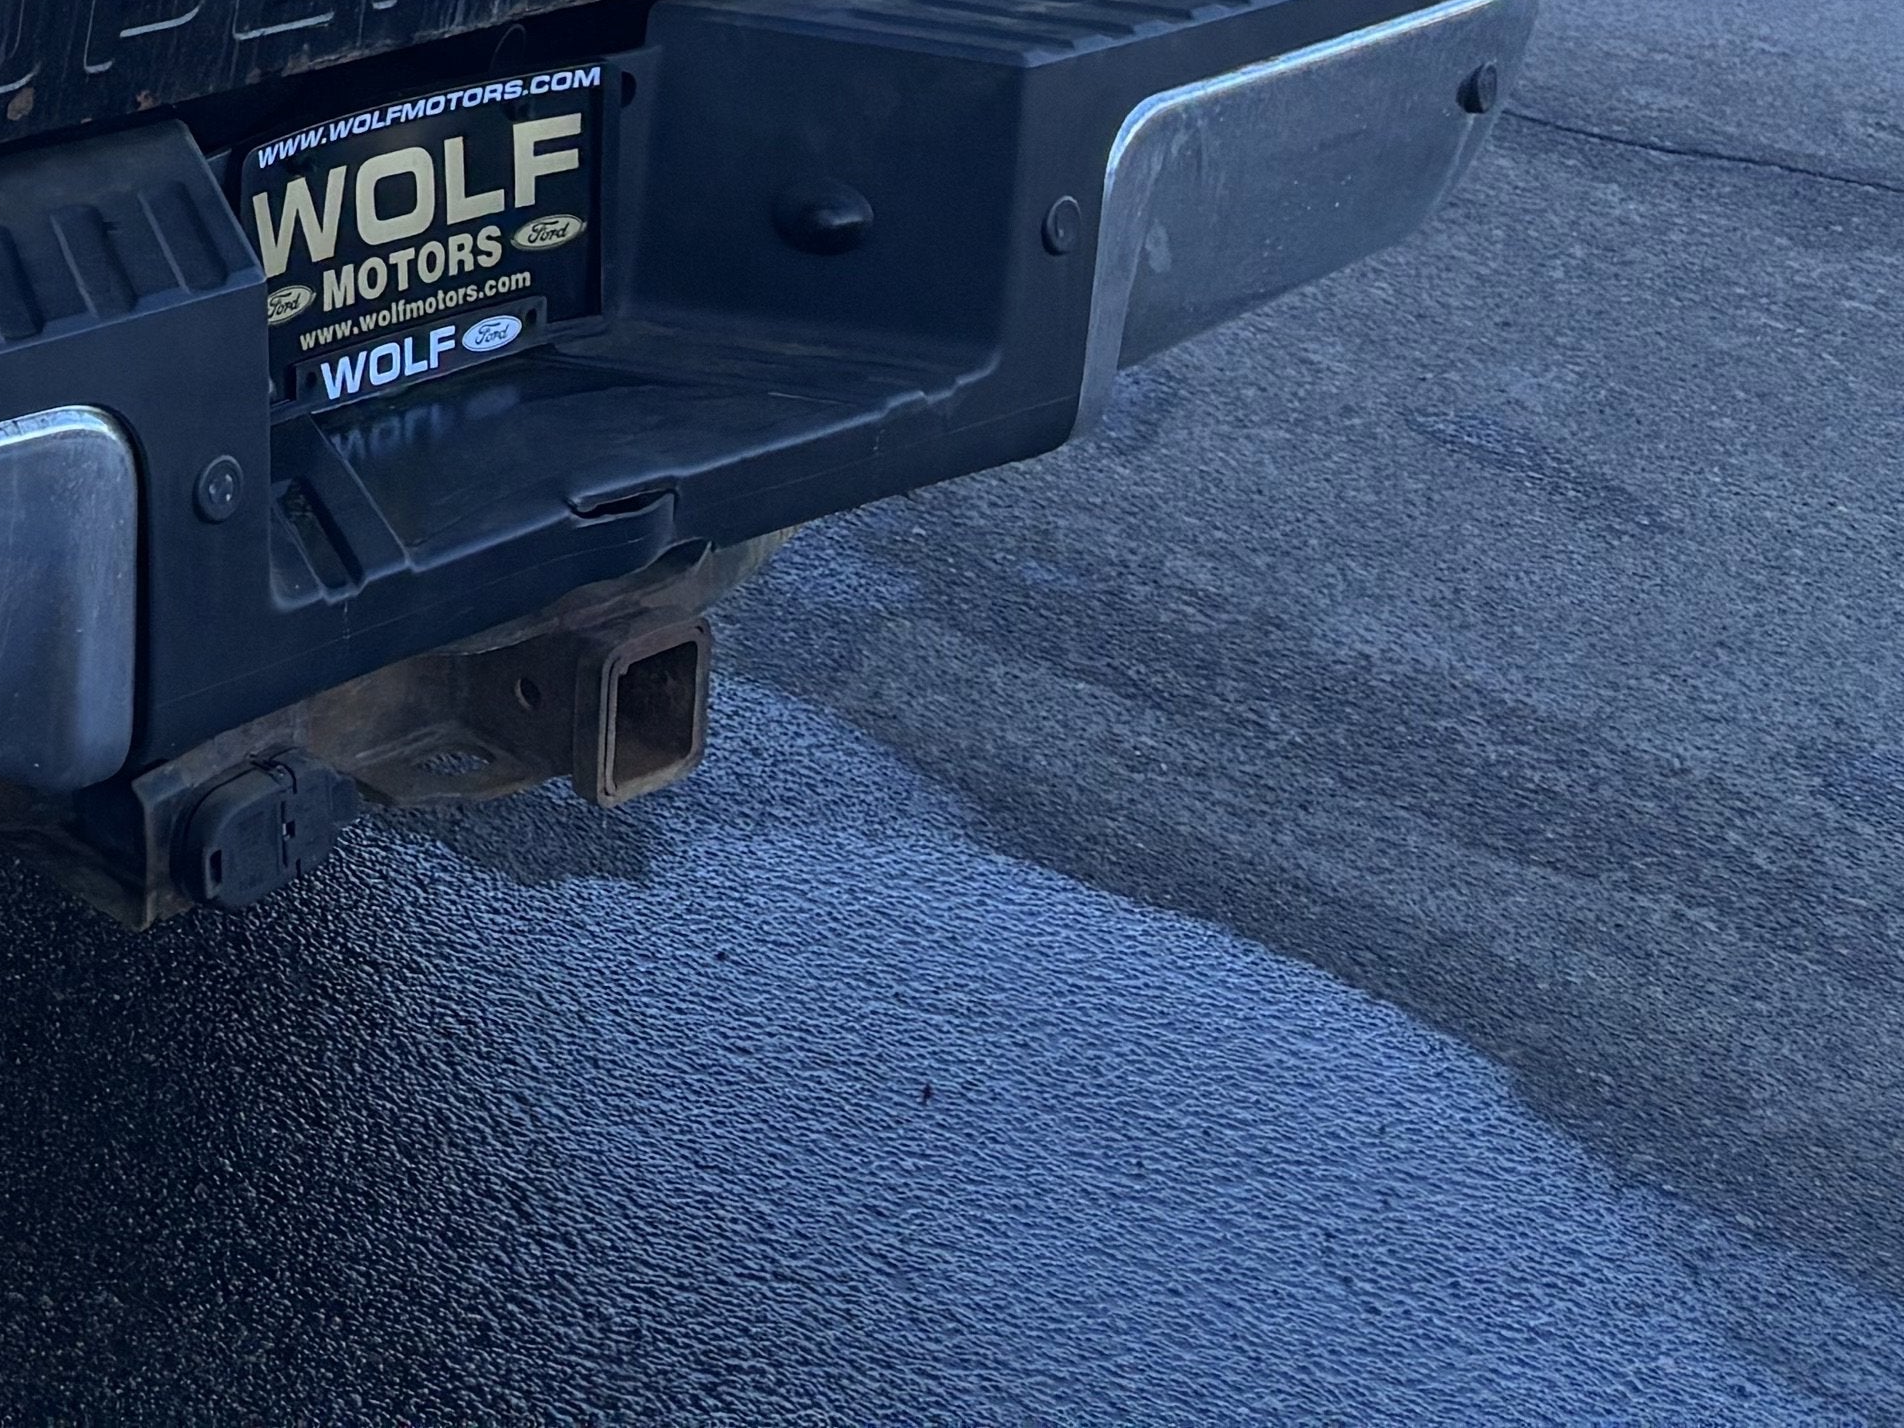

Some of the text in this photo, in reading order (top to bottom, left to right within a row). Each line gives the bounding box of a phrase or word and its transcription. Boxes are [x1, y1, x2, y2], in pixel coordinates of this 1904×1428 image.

[258, 67, 602, 170] WWW.WOLFMOTORS.COM
[252, 112, 583, 278] WOLF
[527, 223, 571, 243] Ford
[268, 225, 502, 318] Ford MOTORS
[300, 269, 531, 351] www.wolfmotors.com
[321, 322, 509, 400] WOLF Ford
